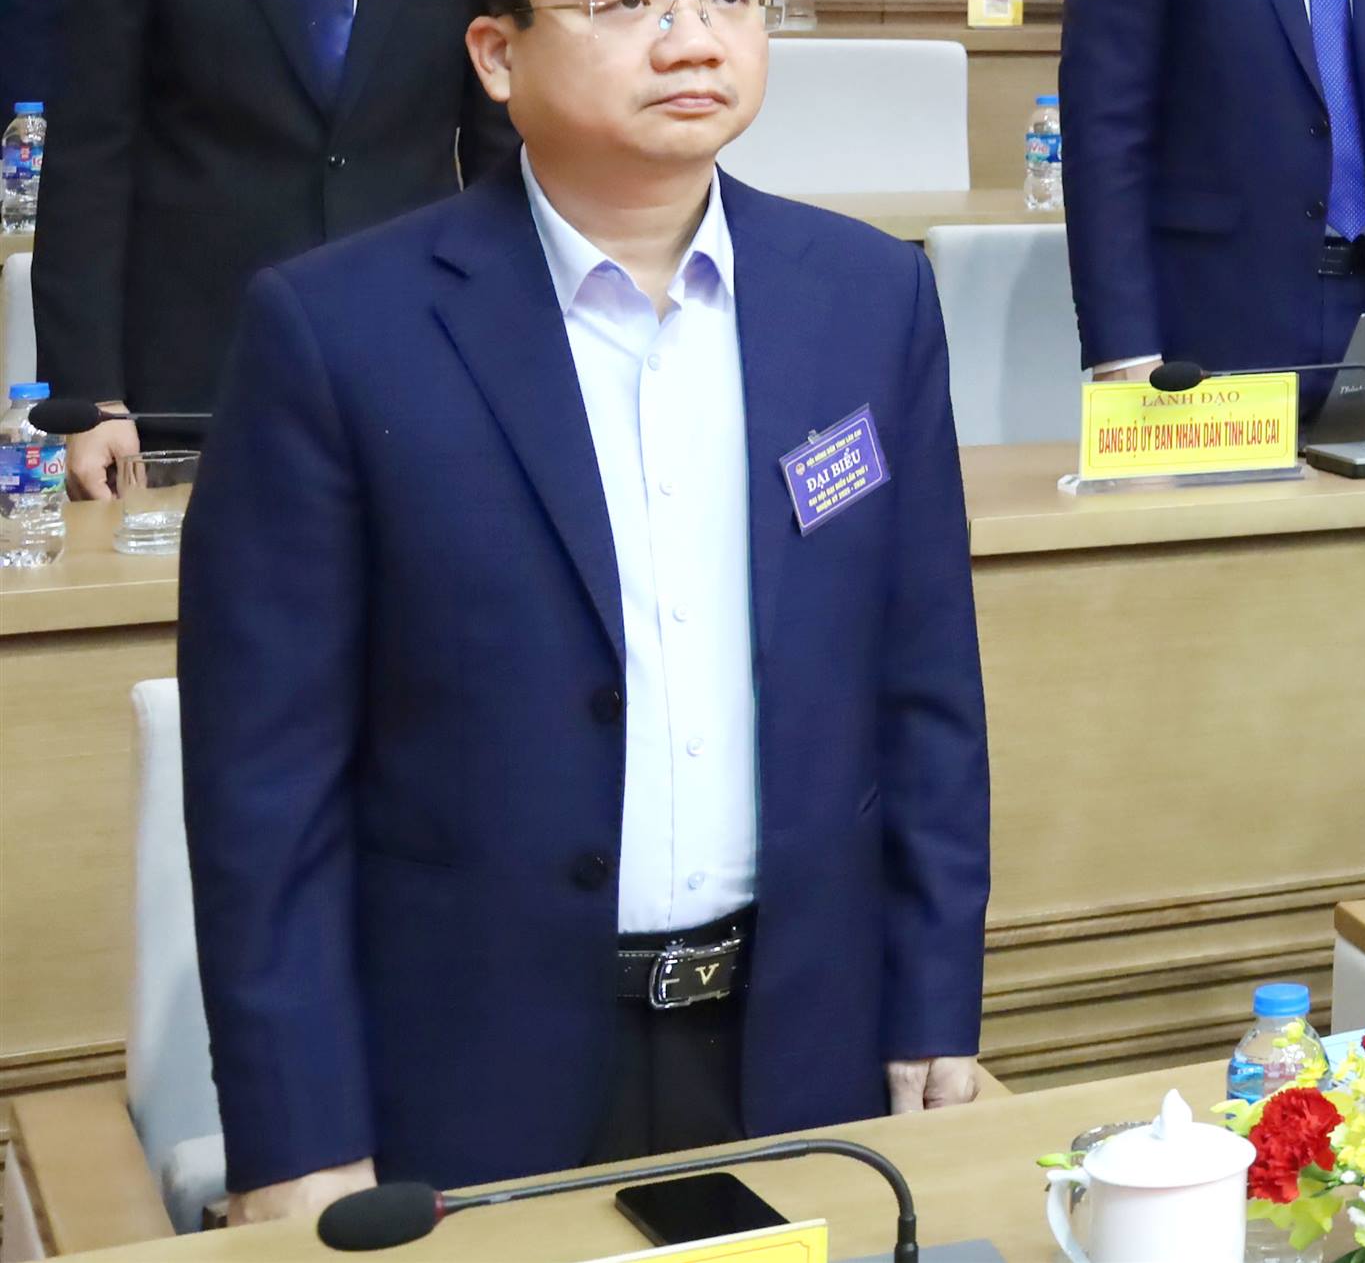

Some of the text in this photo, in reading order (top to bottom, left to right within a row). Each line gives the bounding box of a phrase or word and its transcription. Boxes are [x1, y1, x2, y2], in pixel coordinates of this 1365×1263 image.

[1099, 418, 1124, 454] ĐẢNG
[1126, 420, 1138, 458] BỘ
[1155, 424, 1173, 451] BAN
[1176, 417, 1201, 449] NHÂN
[1203, 416, 1221, 448] DÂN
[1224, 412, 1244, 447] TỈNH
[1246, 414, 1262, 445] LÀO
[1265, 418, 1280, 444] CAI
[806, 447, 861, 493] ĐẠI BIỂU
